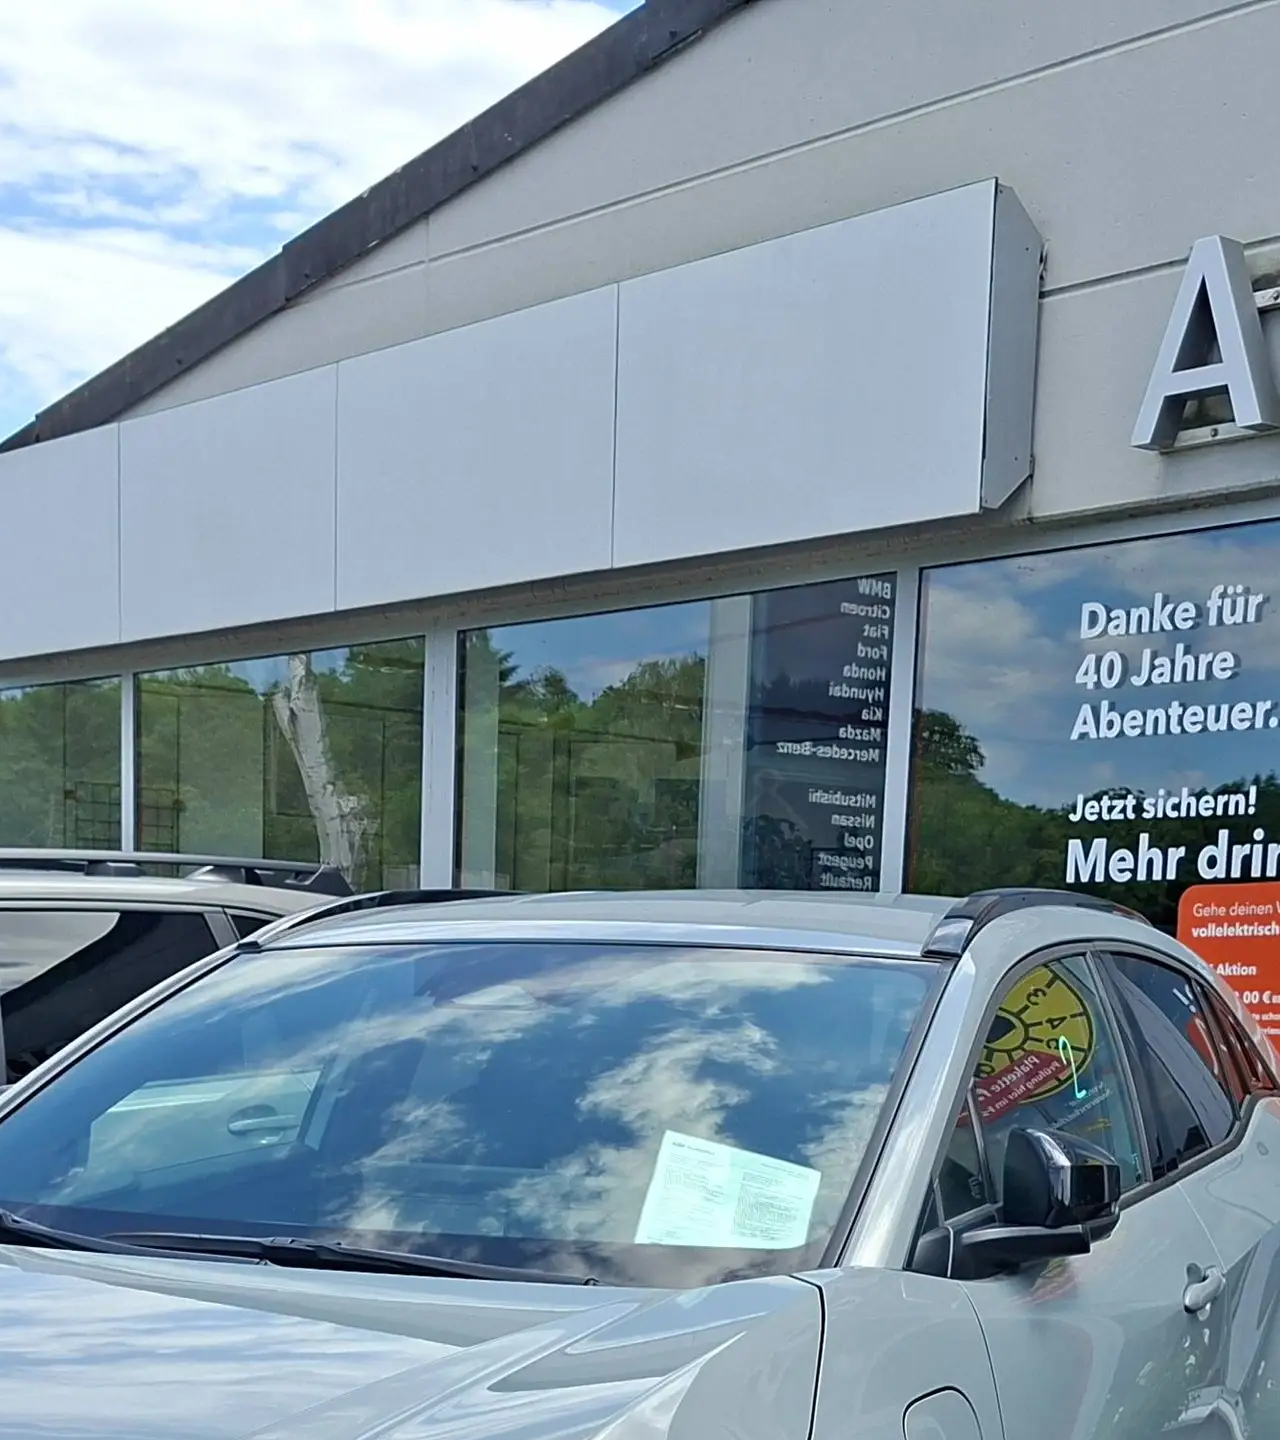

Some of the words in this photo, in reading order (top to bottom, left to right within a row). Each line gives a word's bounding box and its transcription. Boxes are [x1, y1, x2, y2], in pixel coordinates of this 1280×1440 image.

[1080, 592, 1196, 639] Danke
[1207, 585, 1266, 627] für
[1075, 650, 1123, 690] 40
[1130, 643, 1236, 686] Jahre
[1070, 699, 1280, 740] Abenteuer.
[1068, 793, 1137, 822] Jetzt
[1142, 785, 1257, 820] sichern!
[1066, 832, 1186, 884] Mehr
[1192, 903, 1226, 917] Gehe
[1229, 900, 1273, 916] deinen
[1191, 919, 1280, 938] vollelektrisch
[1216, 963, 1257, 976] Aktion
